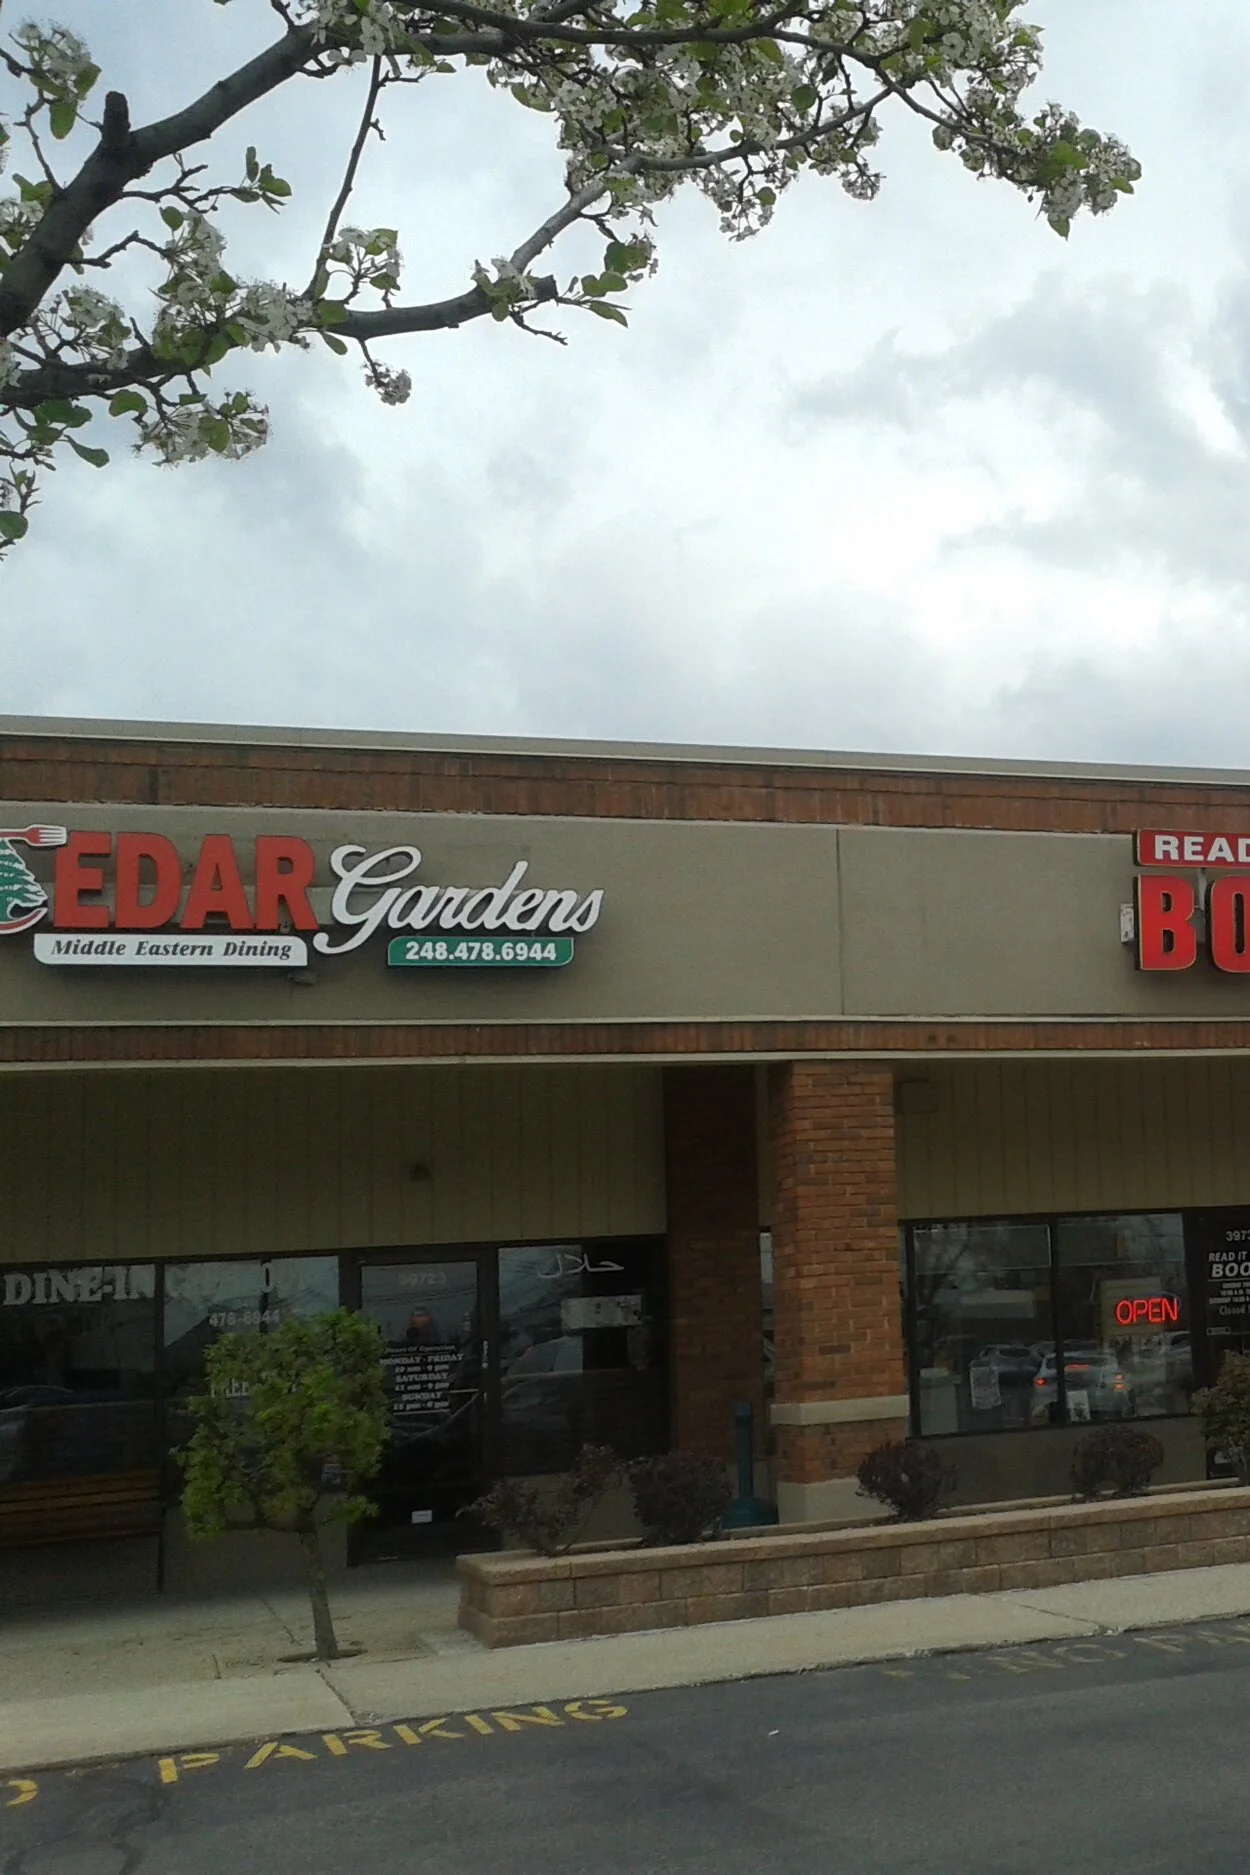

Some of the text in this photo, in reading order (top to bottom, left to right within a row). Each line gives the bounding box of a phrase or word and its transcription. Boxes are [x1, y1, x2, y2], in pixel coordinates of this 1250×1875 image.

[312, 843, 605, 955] Gardens
[51, 939, 292, 961] Middle Eastern Dining
[405, 941, 557, 962] 248.478.6944
[536, 1253, 625, 1279] حلال
[1208, 1252, 1236, 1262] READ
[1238, 1251, 1248, 1261] IT
[4, 1264, 155, 1306] DINE-IN
[1114, 1295, 1179, 1325] OPEN
[427, 1353, 464, 1363] FRIDAY
[395, 1372, 449, 1383] SATURDAY
[156, 1698, 630, 1786] PARKING
